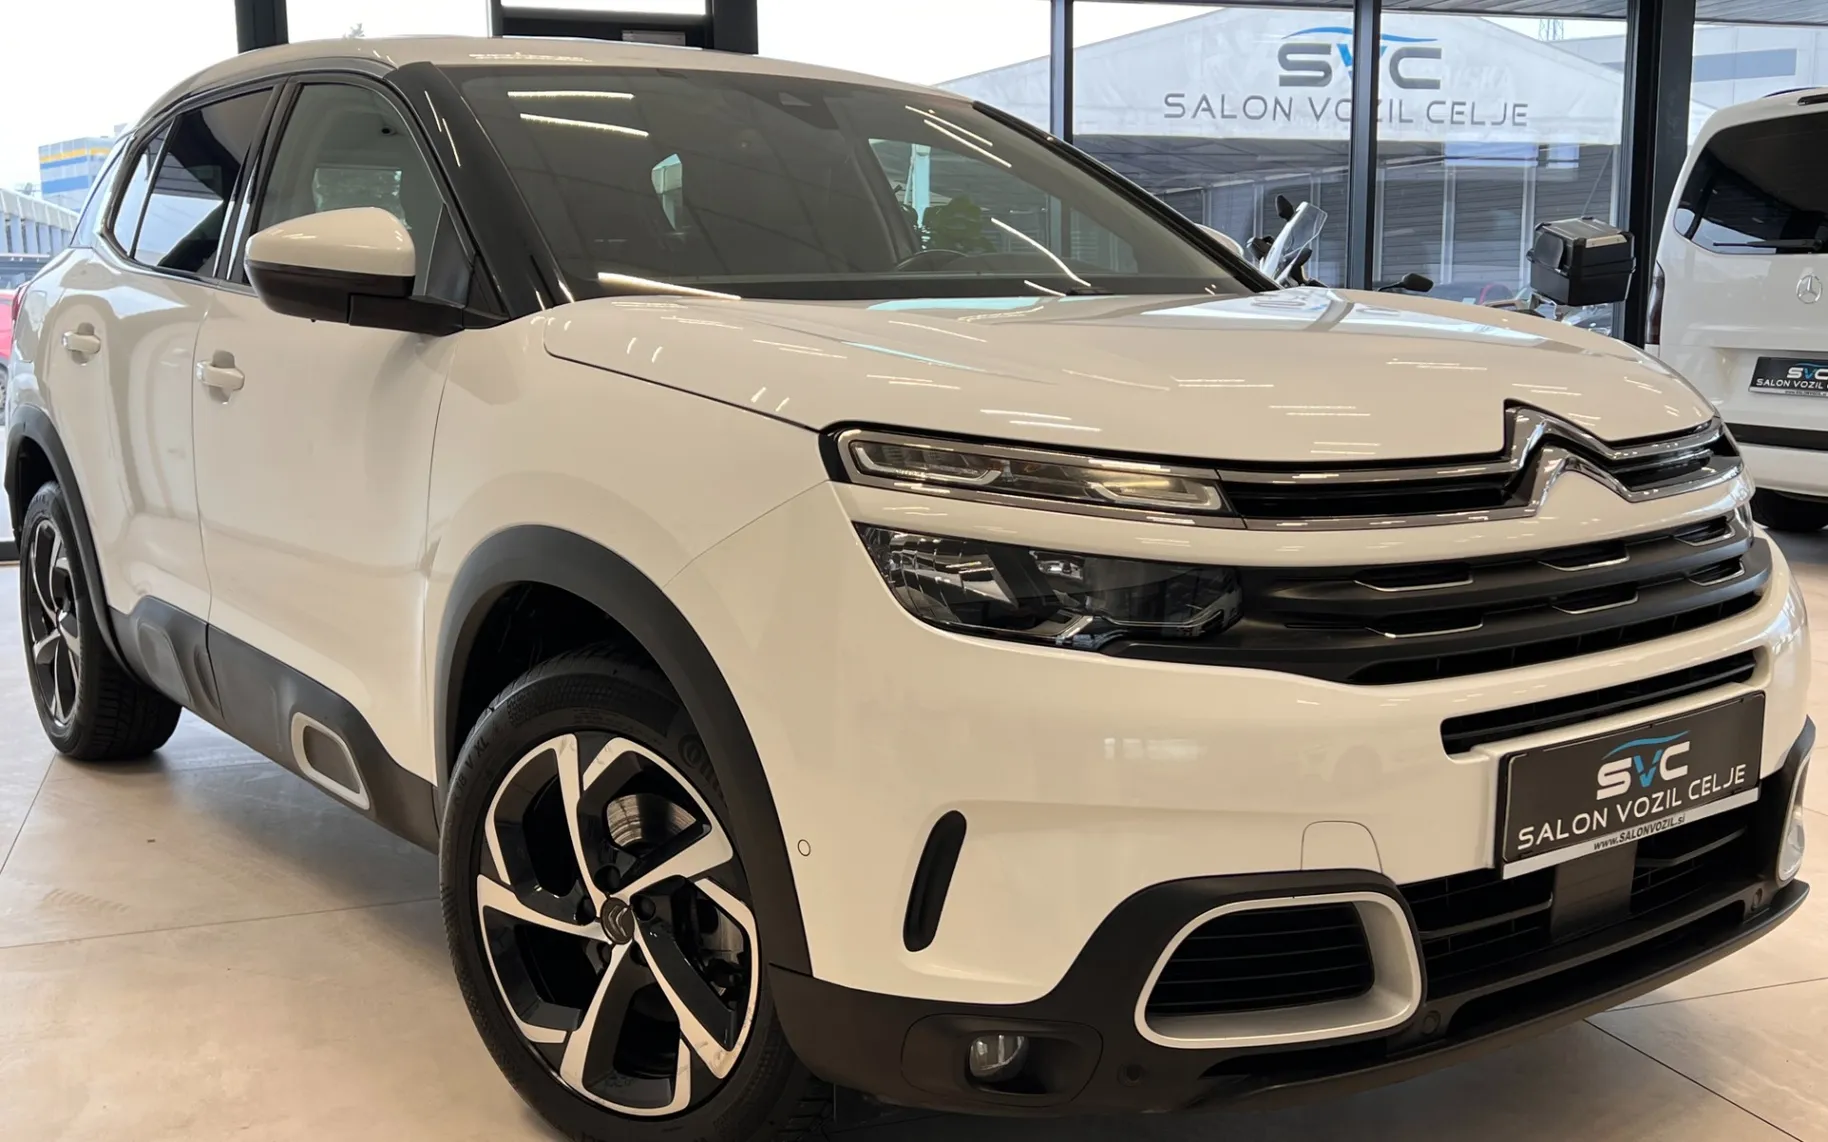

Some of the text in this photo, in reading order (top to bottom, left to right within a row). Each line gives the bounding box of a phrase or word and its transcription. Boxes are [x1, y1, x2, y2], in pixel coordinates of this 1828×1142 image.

[1164, 93, 1293, 121] SALON
[1426, 100, 1528, 126] CELJE
[1756, 378, 1791, 387] SALON
[1793, 380, 1824, 389] VOZIL
[474, 736, 490, 758] XL
[1596, 741, 1691, 800] SVC
[1517, 763, 1746, 850] SALON VOZIL CELJE
[1593, 814, 1686, 851] www.SALONVOZIL.si
